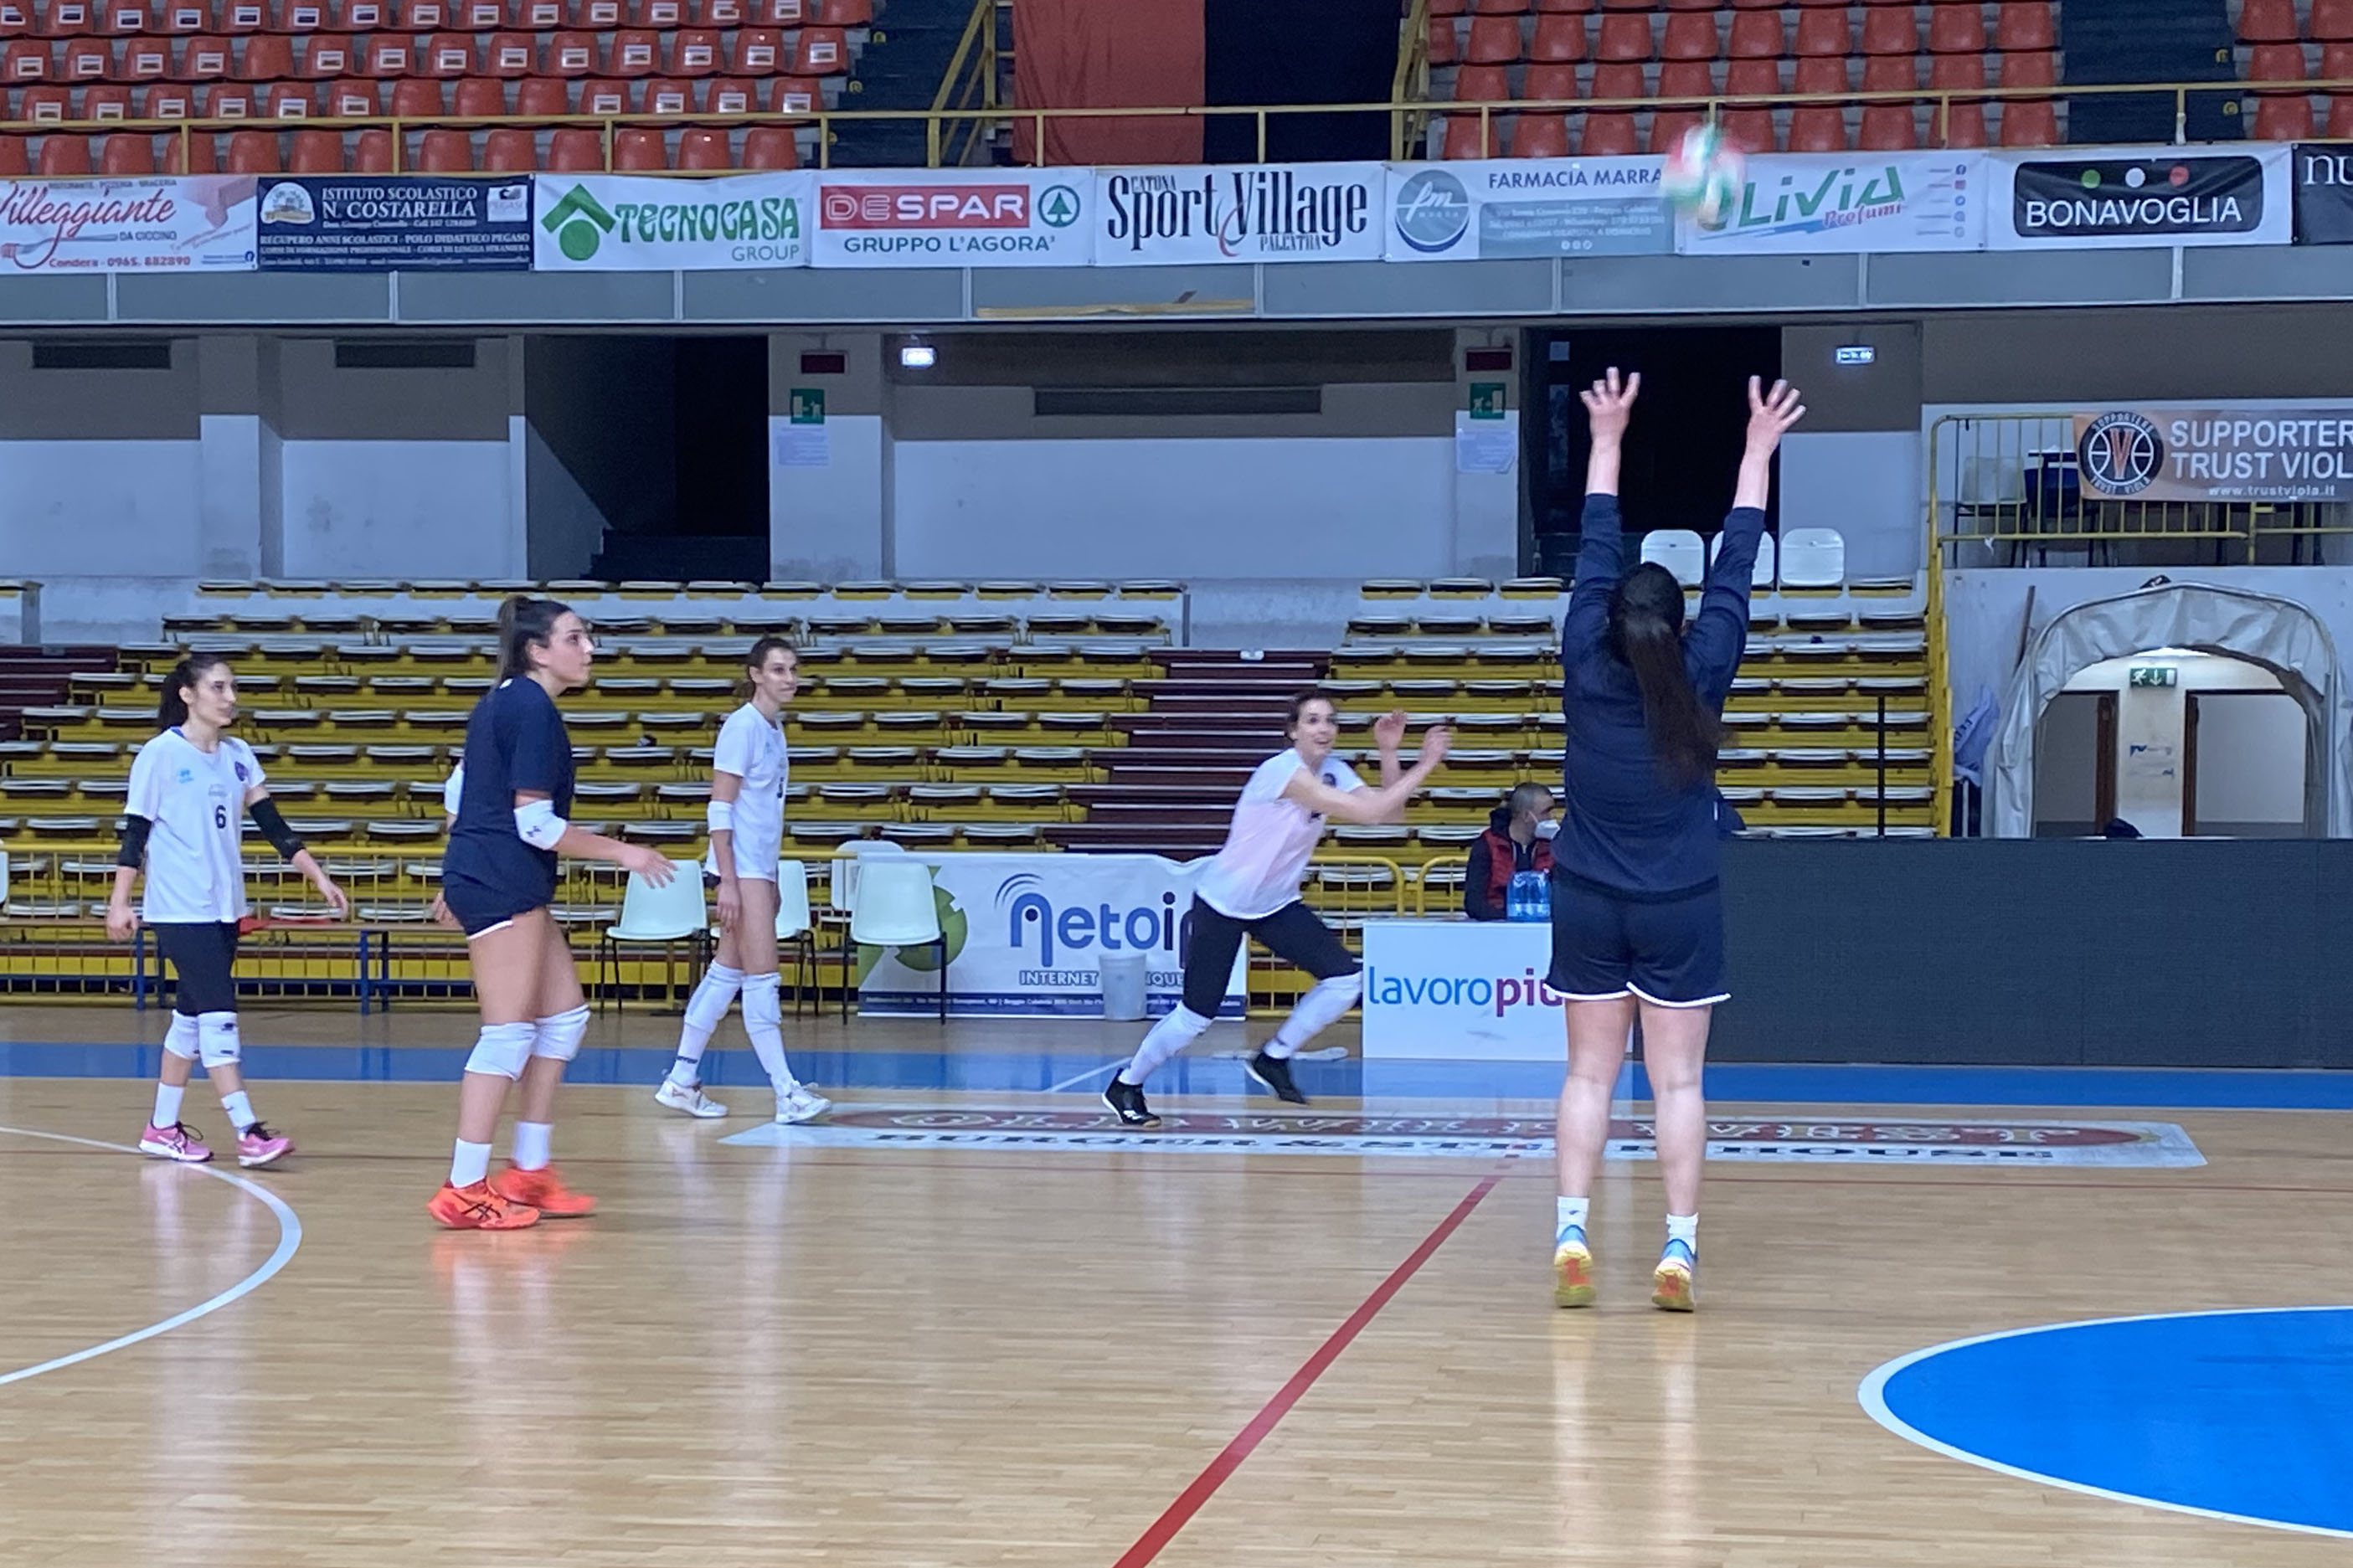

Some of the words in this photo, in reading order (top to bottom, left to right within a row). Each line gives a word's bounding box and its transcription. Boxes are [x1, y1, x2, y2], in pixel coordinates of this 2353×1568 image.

[1131, 175, 1176, 192] CATONA
[1488, 171, 1588, 188] FARMACIA
[1593, 168, 1662, 185] MARRA
[322, 188, 384, 201] ISTITUTO
[388, 187, 477, 200] SCOLASTICO
[322, 201, 342, 219] N.
[347, 200, 476, 218] COSTARELLA
[825, 193, 1023, 221] DESPAR
[1108, 173, 1218, 251] Sport
[1232, 171, 1367, 247] Village
[2026, 196, 2242, 228] BONAVOGLIA
[120, 231, 133, 241] DA
[260, 235, 313, 244] RECUPERO
[342, 234, 398, 244] SCOLASTICI
[404, 234, 433, 244] POLO
[435, 234, 490, 244] DIDATTICO
[492, 233, 530, 242] PEGASO
[843, 236, 941, 252] GRUPPO
[731, 244, 800, 261] GROUP
[2170, 452, 2273, 479] TRUST
[214, 804, 227, 829] 6
[1019, 970, 1099, 986] INTERNET
